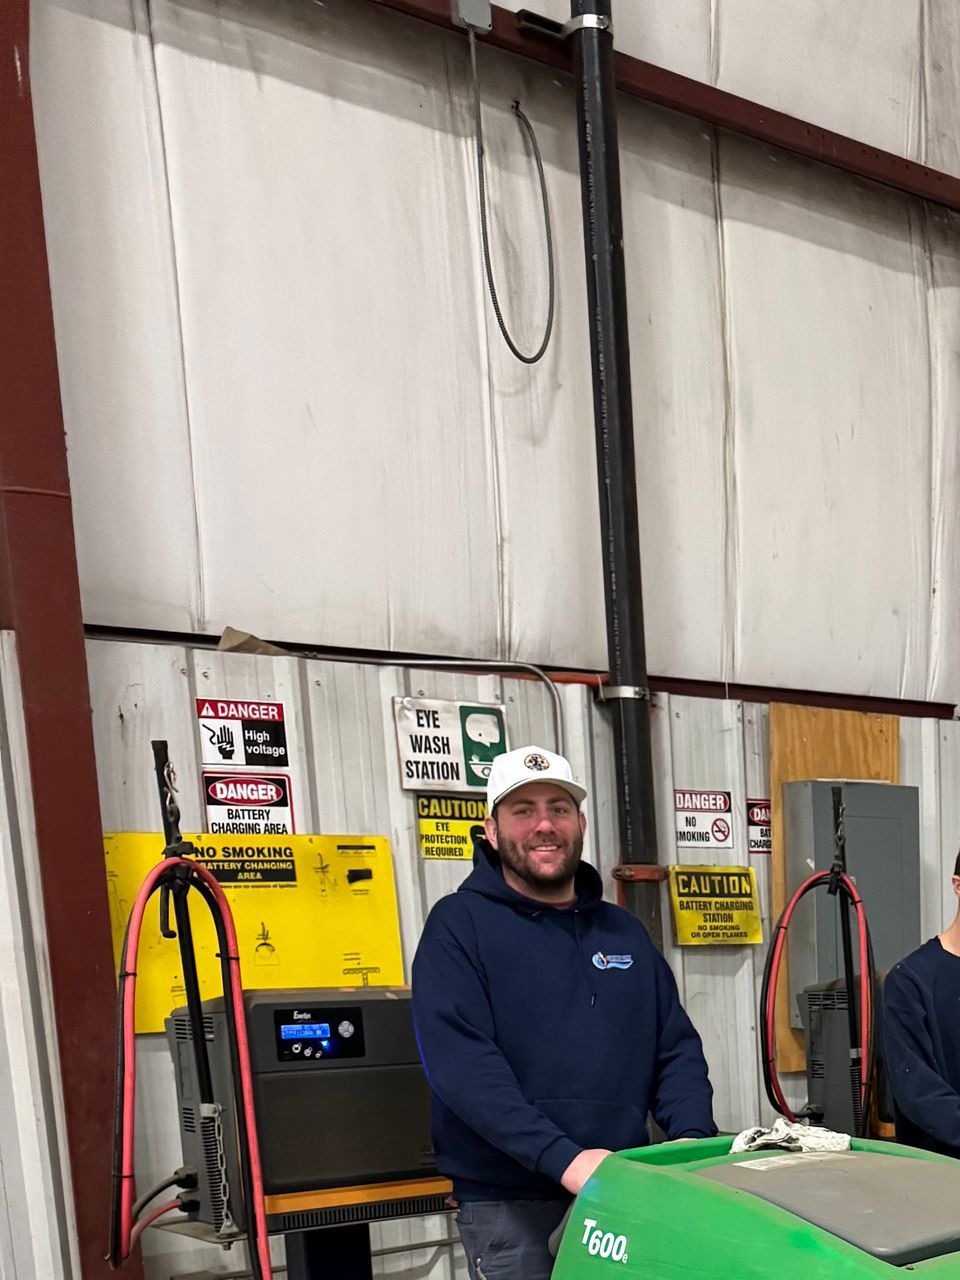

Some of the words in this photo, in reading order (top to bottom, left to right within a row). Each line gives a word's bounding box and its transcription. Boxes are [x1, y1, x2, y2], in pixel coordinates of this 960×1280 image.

[217, 702, 279, 720] DANGER
[415, 708, 441, 729] EYE
[244, 729, 270, 743] High
[245, 744, 285, 757] voltage
[409, 734, 451, 755] WASH
[405, 759, 460, 781] STATION
[215, 783, 278, 801] DANGER
[418, 797, 488, 818] CAUTION
[675, 793, 725, 810] DANGER
[227, 808, 271, 820] BATTERY
[435, 821, 450, 832] EYE
[685, 816, 697, 827] NO
[211, 822, 261, 834] CHARGING
[263, 823, 288, 834] AREA
[420, 833, 467, 845] PROTECTION
[194, 846, 217, 858] NO
[222, 846, 294, 858] SMOKING
[425, 846, 464, 857] REQUIRED
[244, 861, 293, 870] CHANGING
[237, 871, 262, 880] AREA
[677, 875, 751, 894] CAUTION
[679, 900, 712, 911] BATTERY
[714, 900, 754, 911] CHARGING
[702, 912, 734, 923] STATION
